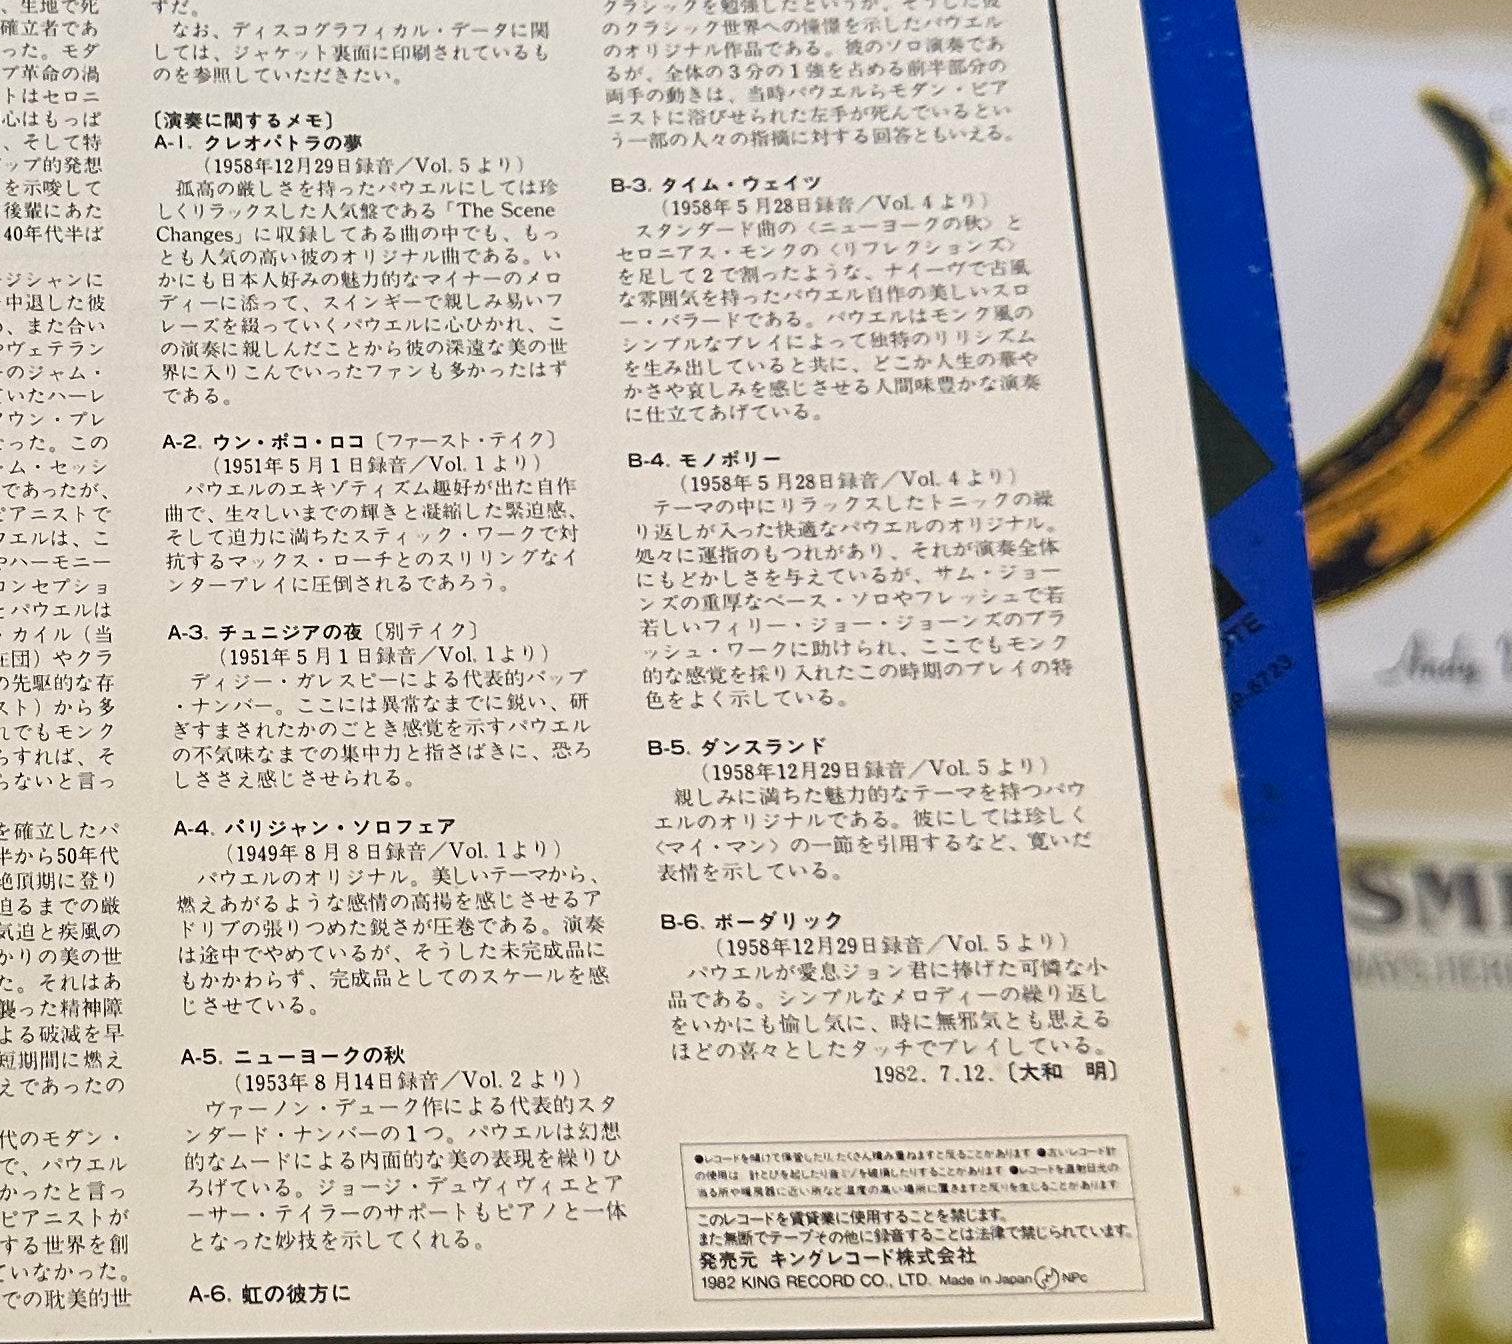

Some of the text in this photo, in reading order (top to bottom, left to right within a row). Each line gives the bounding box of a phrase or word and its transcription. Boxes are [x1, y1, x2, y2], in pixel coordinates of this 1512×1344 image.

[205, 133, 364, 153] クレオパトラの夢
[661, 174, 822, 195] タイム・ウェイツ
[679, 451, 782, 470] モノポリー
[701, 737, 828, 757] ダンスランド
[224, 817, 457, 837] パリジャン・ソロフェア
[657, 861, 844, 882] 表情を示している。
[713, 911, 844, 932] ボーダリック
[234, 1044, 407, 1067] ニューヨークの秋
[188, 1229, 485, 1253] となった妙技を示してくれる。
[698, 1245, 978, 1270] 発売元 キングレコード株式会社
[701, 1275, 736, 1291] 1982
[741, 1274, 781, 1290] KING
[786, 1273, 856, 1289] RECORD
[938, 1274, 975, 1287] Made
[979, 1274, 993, 1285] in
[994, 1273, 1033, 1287] Japan
[242, 1281, 352, 1305] 虹の彼方に
